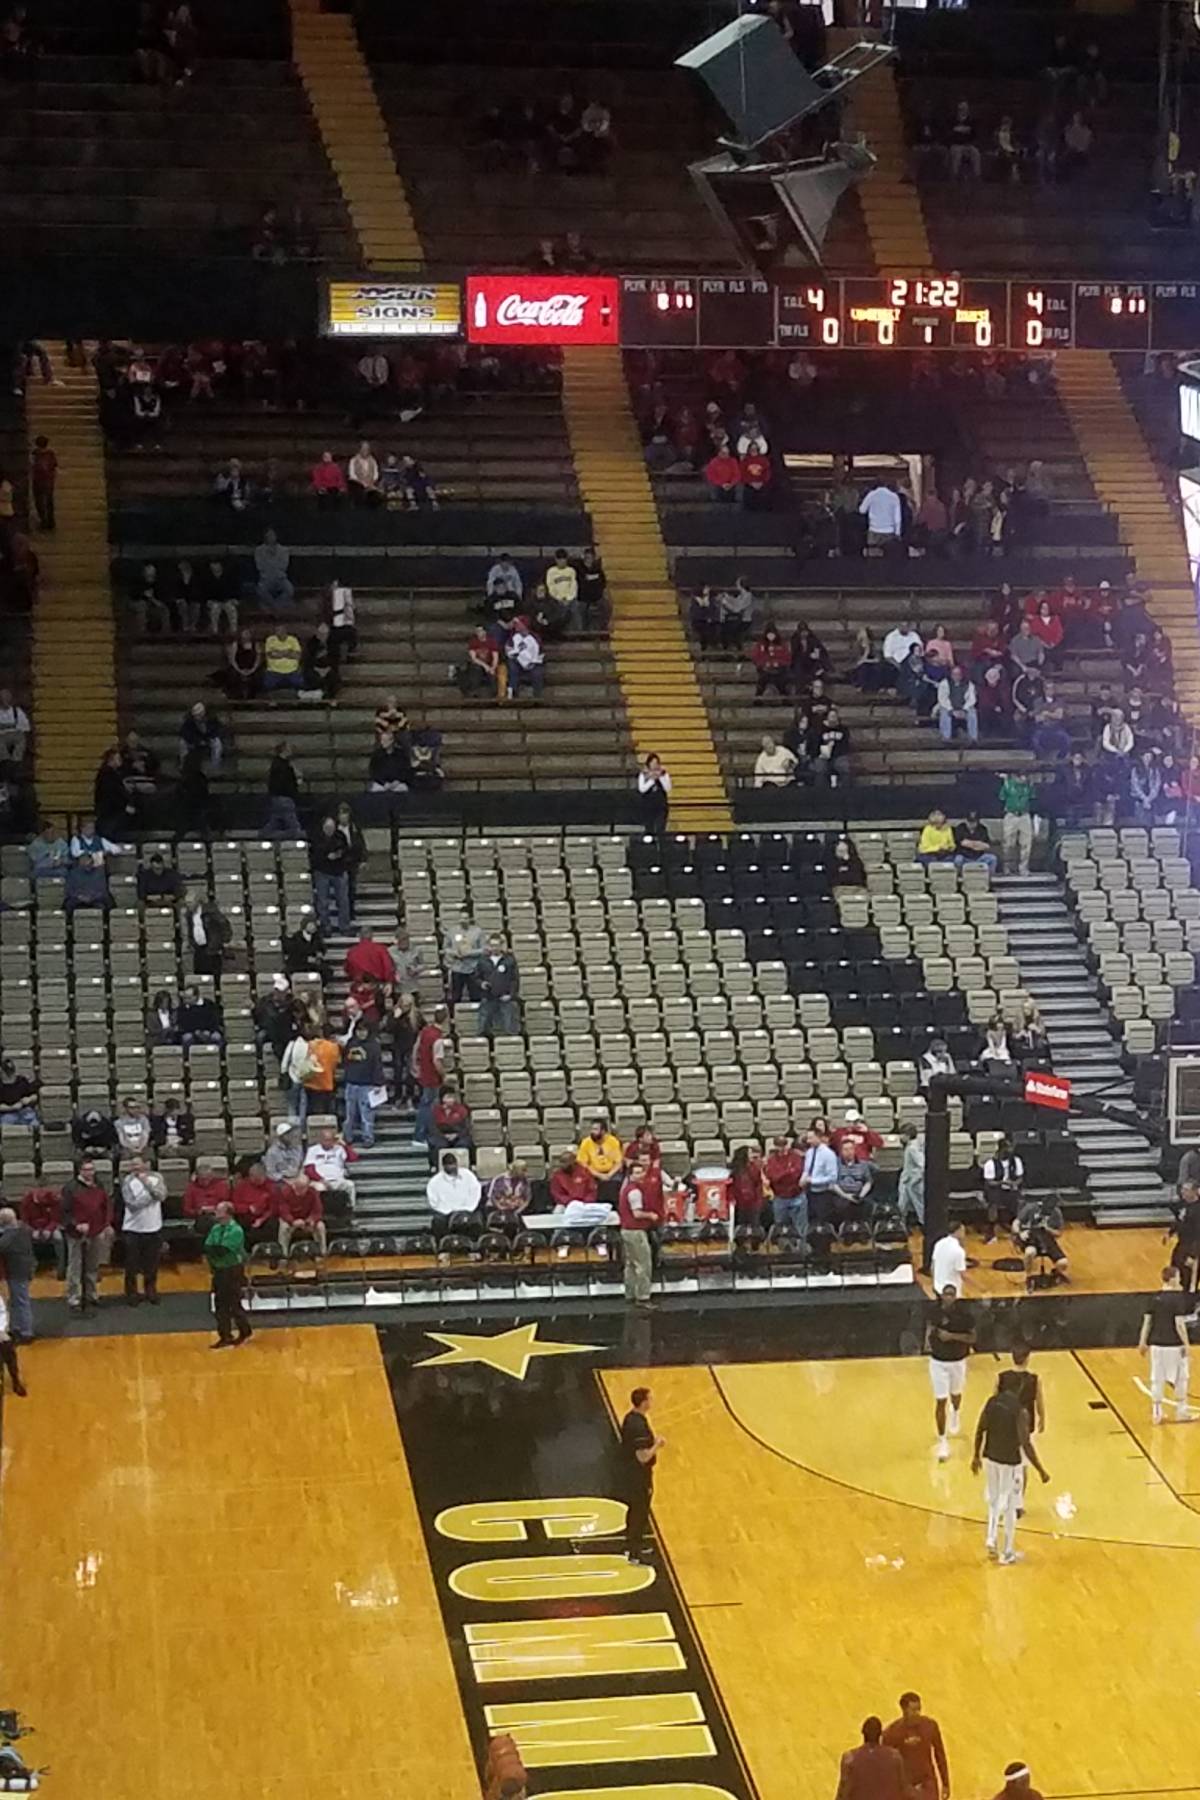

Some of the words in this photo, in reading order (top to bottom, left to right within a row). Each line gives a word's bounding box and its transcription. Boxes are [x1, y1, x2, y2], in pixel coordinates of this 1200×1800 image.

[807, 288, 824, 312] 4
[891, 279, 960, 307] 21:22
[1027, 292, 1043, 315] 4
[355, 307, 435, 319] SIGNS
[823, 317, 839, 345] 0
[878, 320, 894, 345] 0
[975, 320, 992, 347] 0
[1026, 319, 1043, 346] 0
